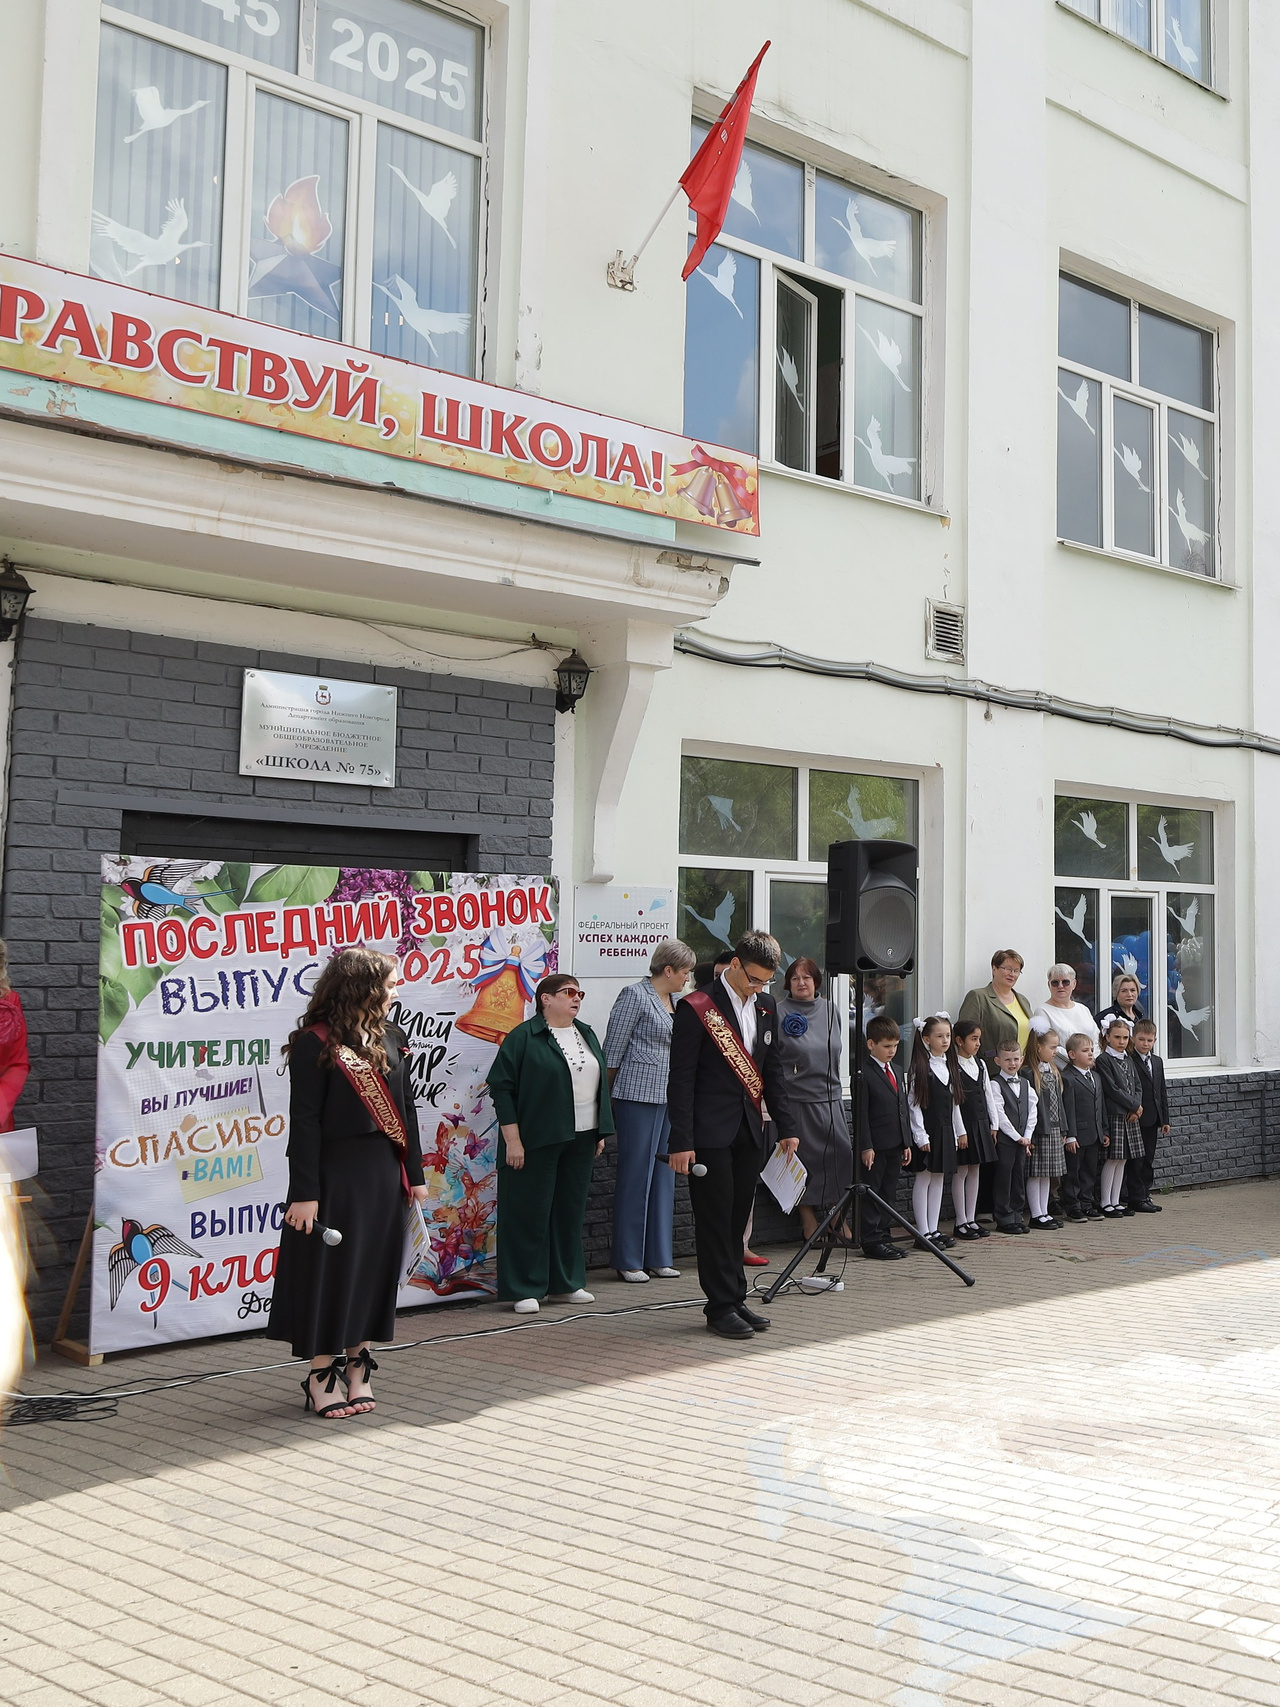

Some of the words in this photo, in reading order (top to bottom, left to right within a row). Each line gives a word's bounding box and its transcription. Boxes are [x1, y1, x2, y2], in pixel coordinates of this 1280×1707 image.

[329, 18, 469, 111] 2025
[420, 394, 665, 493] ШКОЛА!
[260, 702, 309, 713] Администрация
[310, 707, 330, 716] города
[331, 710, 359, 719] Нижнего
[360, 713, 390, 722] Новгорода
[288, 712, 327, 722] Департамент
[328, 717, 365, 726] образования
[259, 723, 331, 737] МУНИЦИПАЛЬНОЕ
[332, 732, 382, 742] БЮДЖЕТНОЕ
[273, 733, 368, 748] ОБЩЕОБРАЗОВАТЕЛЬНОЕ
[294, 743, 348, 753] УЧРЕЖДЕНИЕ
[256, 755, 331, 772] «ШКОЛА
[336, 761, 355, 774] №
[359, 764, 382, 776] 75»
[122, 894, 400, 966] ПОСЛЕДНИЙ
[413, 886, 553, 936] ЗВОНОК
[578, 921, 639, 930] ФЕДЕРАЛЬНЫЙ
[640, 922, 670, 930] ПРОЕКТ
[578, 934, 613, 943] УСПЕХ
[600, 948, 648, 957] РЕБЕНКА
[125, 1038, 270, 1069] УЧИТЕЛЯ!
[714, 1027, 753, 1077] Выпускник
[141, 1094, 169, 1115] ВЫ
[173, 1077, 253, 1109] ЛУЧШИЕ!
[109, 1114, 286, 1168] СПАСИБО
[193, 1154, 253, 1182] ВАМ!
[138, 1257, 171, 1312] 9
